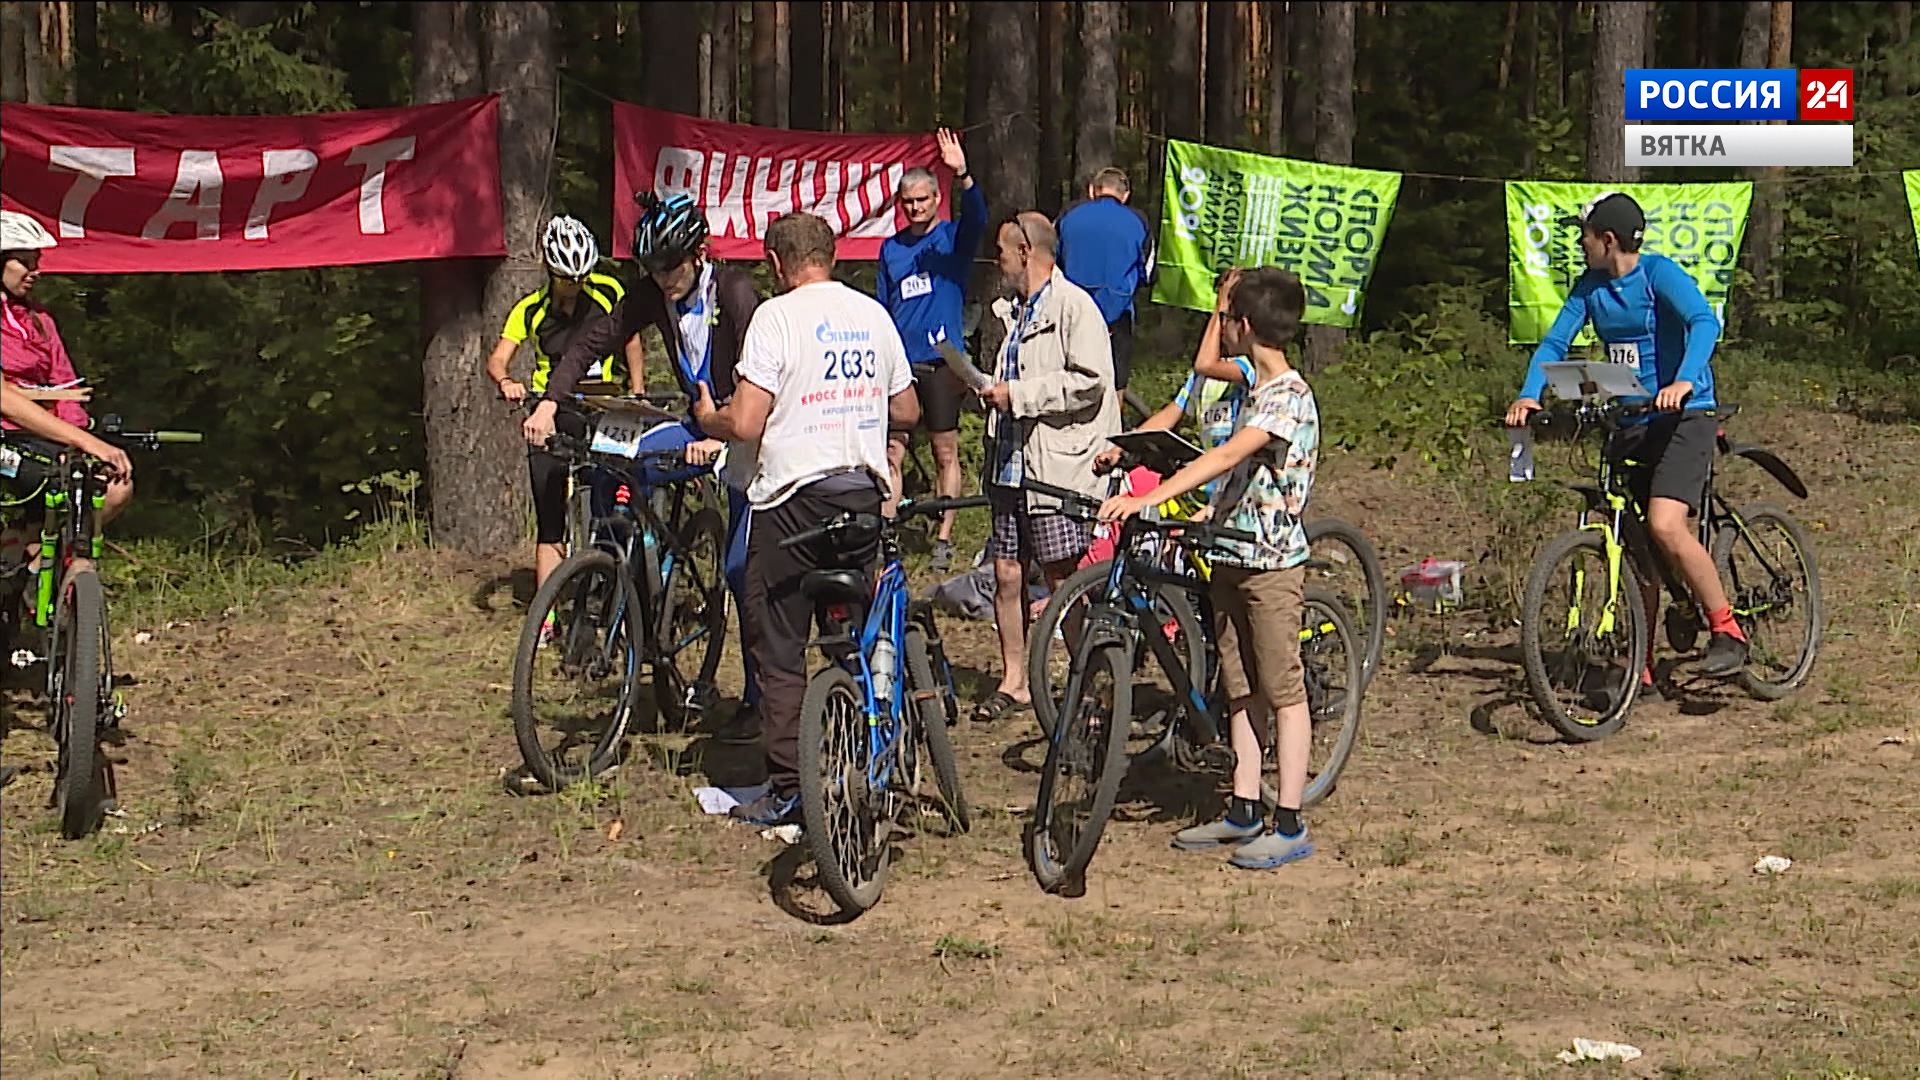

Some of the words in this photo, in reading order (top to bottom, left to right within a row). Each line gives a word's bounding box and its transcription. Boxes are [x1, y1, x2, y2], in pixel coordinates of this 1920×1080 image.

[0, 134, 416, 240] ТАРТ
[654, 146, 904, 238] ФИНИШ
[1274, 180, 1314, 271] ЖИЗН
[1305, 184, 1347, 308] НОРМА
[1339, 188, 1379, 293] СПОРТ
[1702, 202, 1735, 299] СПОРТ
[823, 349, 877, 380] 2633
